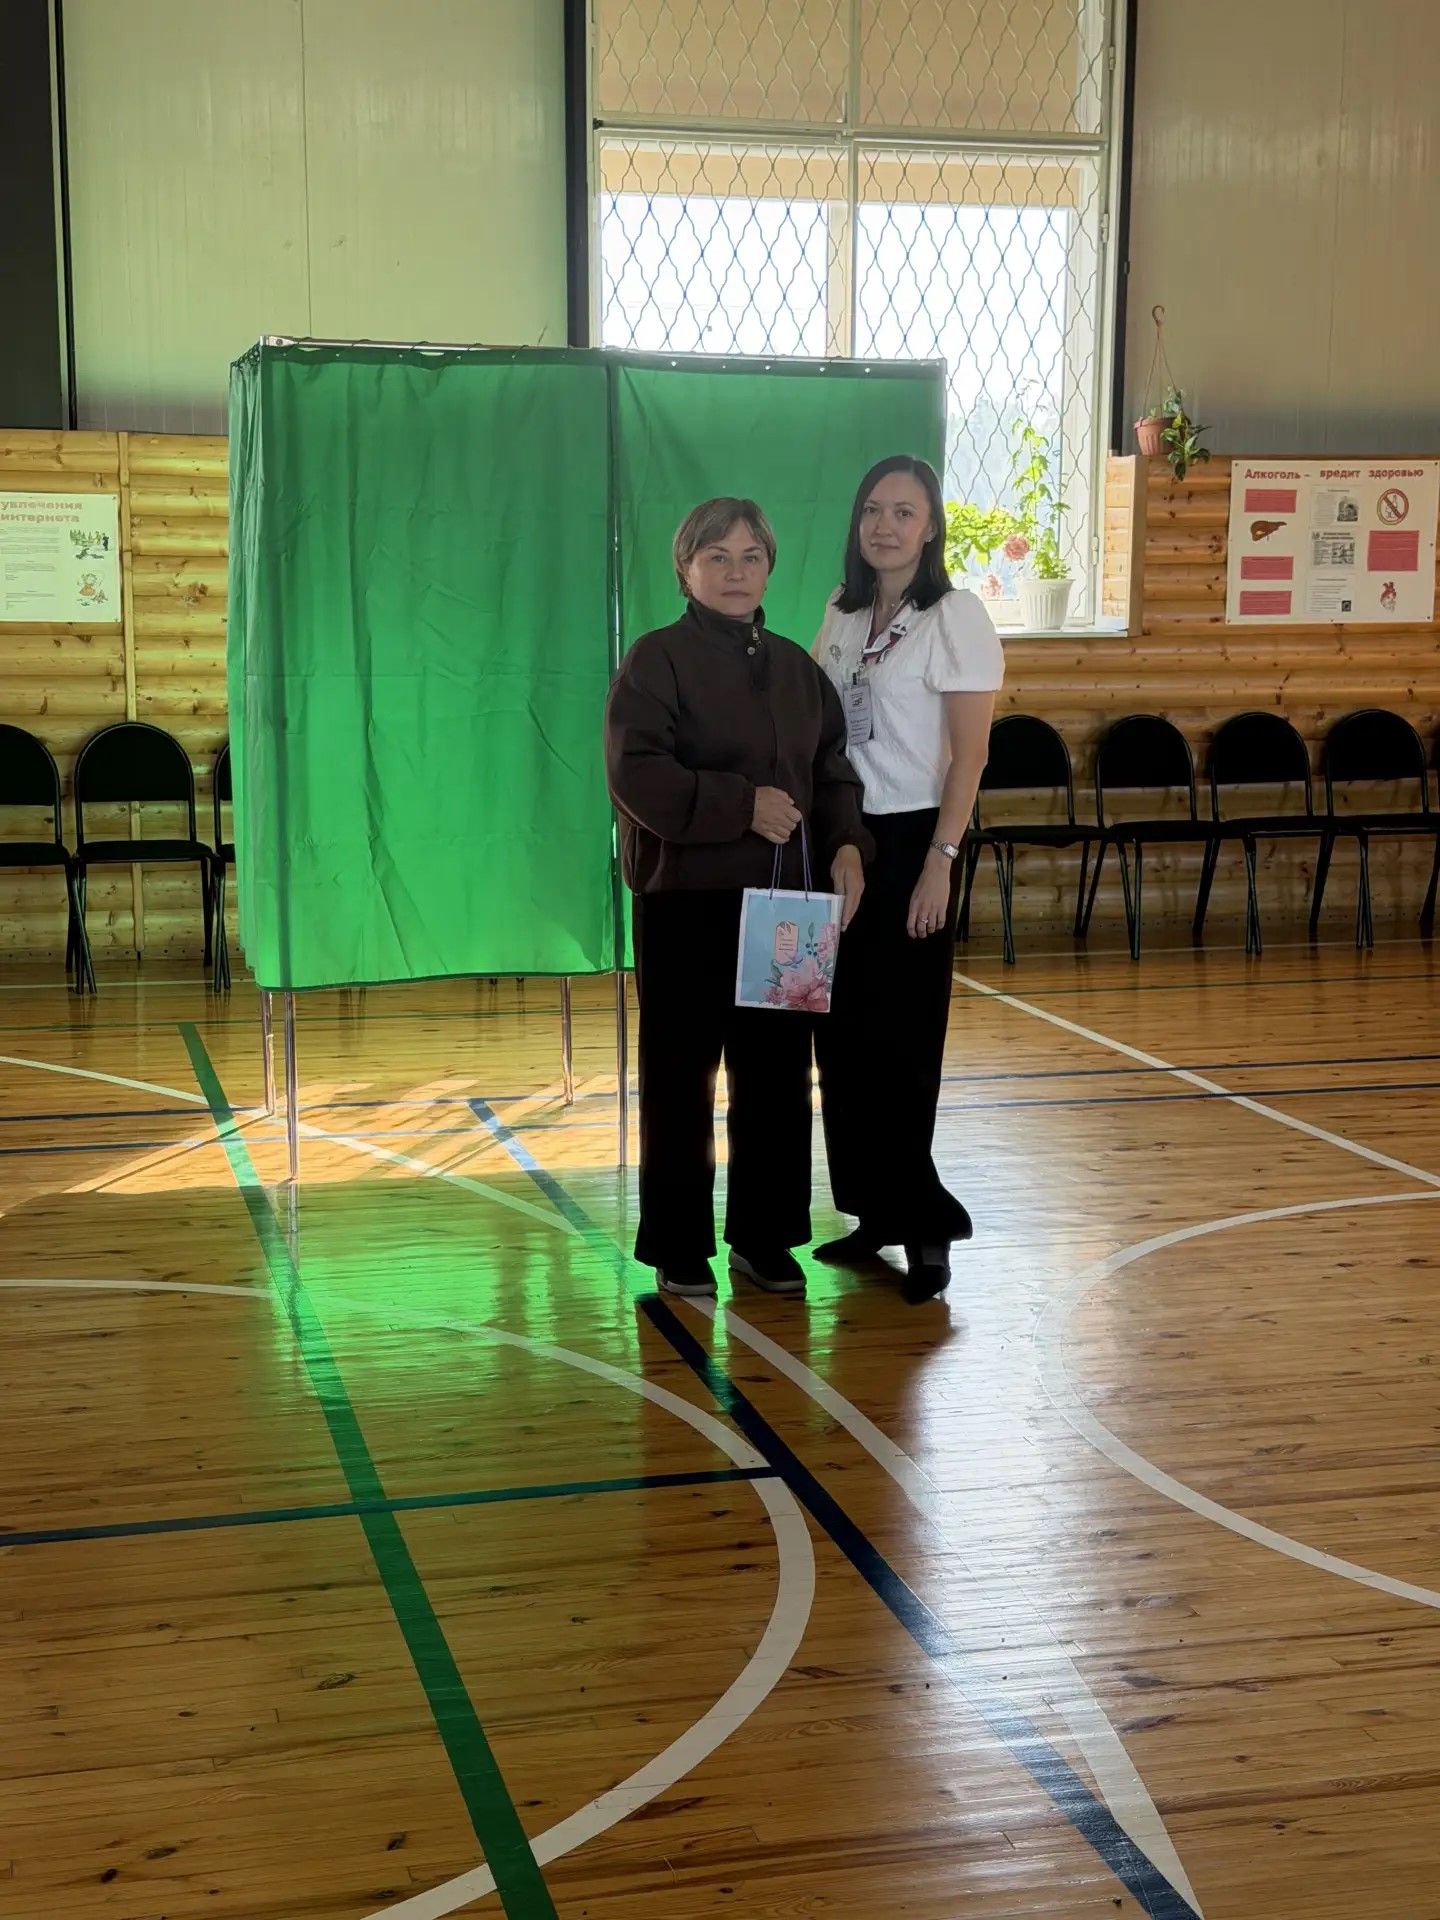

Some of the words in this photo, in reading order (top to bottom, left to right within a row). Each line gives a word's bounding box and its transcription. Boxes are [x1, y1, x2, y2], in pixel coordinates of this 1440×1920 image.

[1244, 468, 1301, 480] Алкоголь
[1320, 468, 1361, 479] вредит
[1368, 468, 1424, 479] здоровью
[0, 513, 80, 523] интернета
